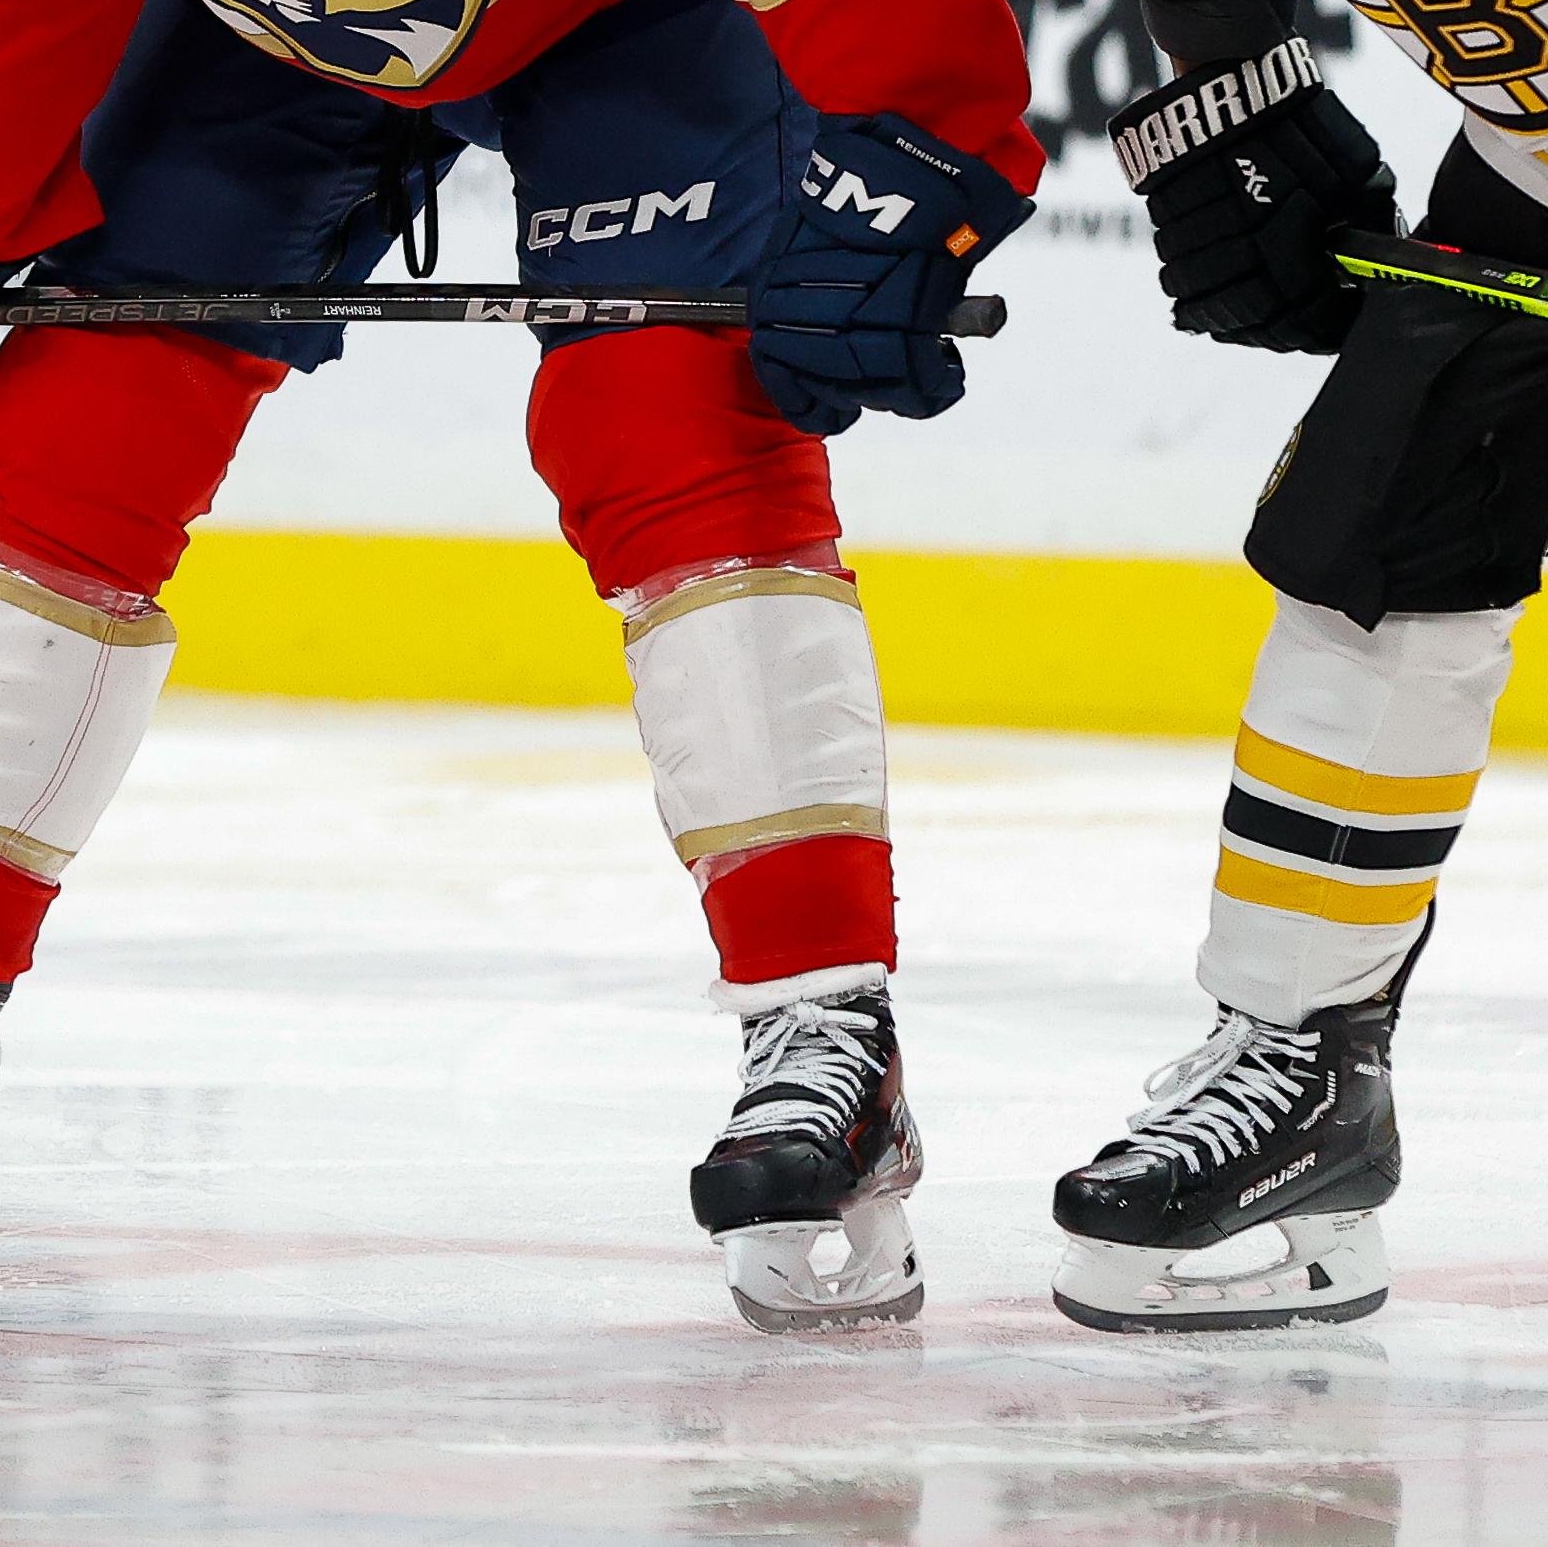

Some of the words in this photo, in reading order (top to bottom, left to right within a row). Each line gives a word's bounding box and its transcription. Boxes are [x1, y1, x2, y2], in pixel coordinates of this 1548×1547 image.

[1114, 37, 1323, 191] WARRIOR
[896, 136, 962, 176] REINHART
[527, 181, 716, 252] CCM
[5, 302, 231, 325] JETSPEED
[322, 304, 383, 316] REINHART
[463, 297, 648, 324] CCM
[1238, 1151, 1317, 1209] BAUER
